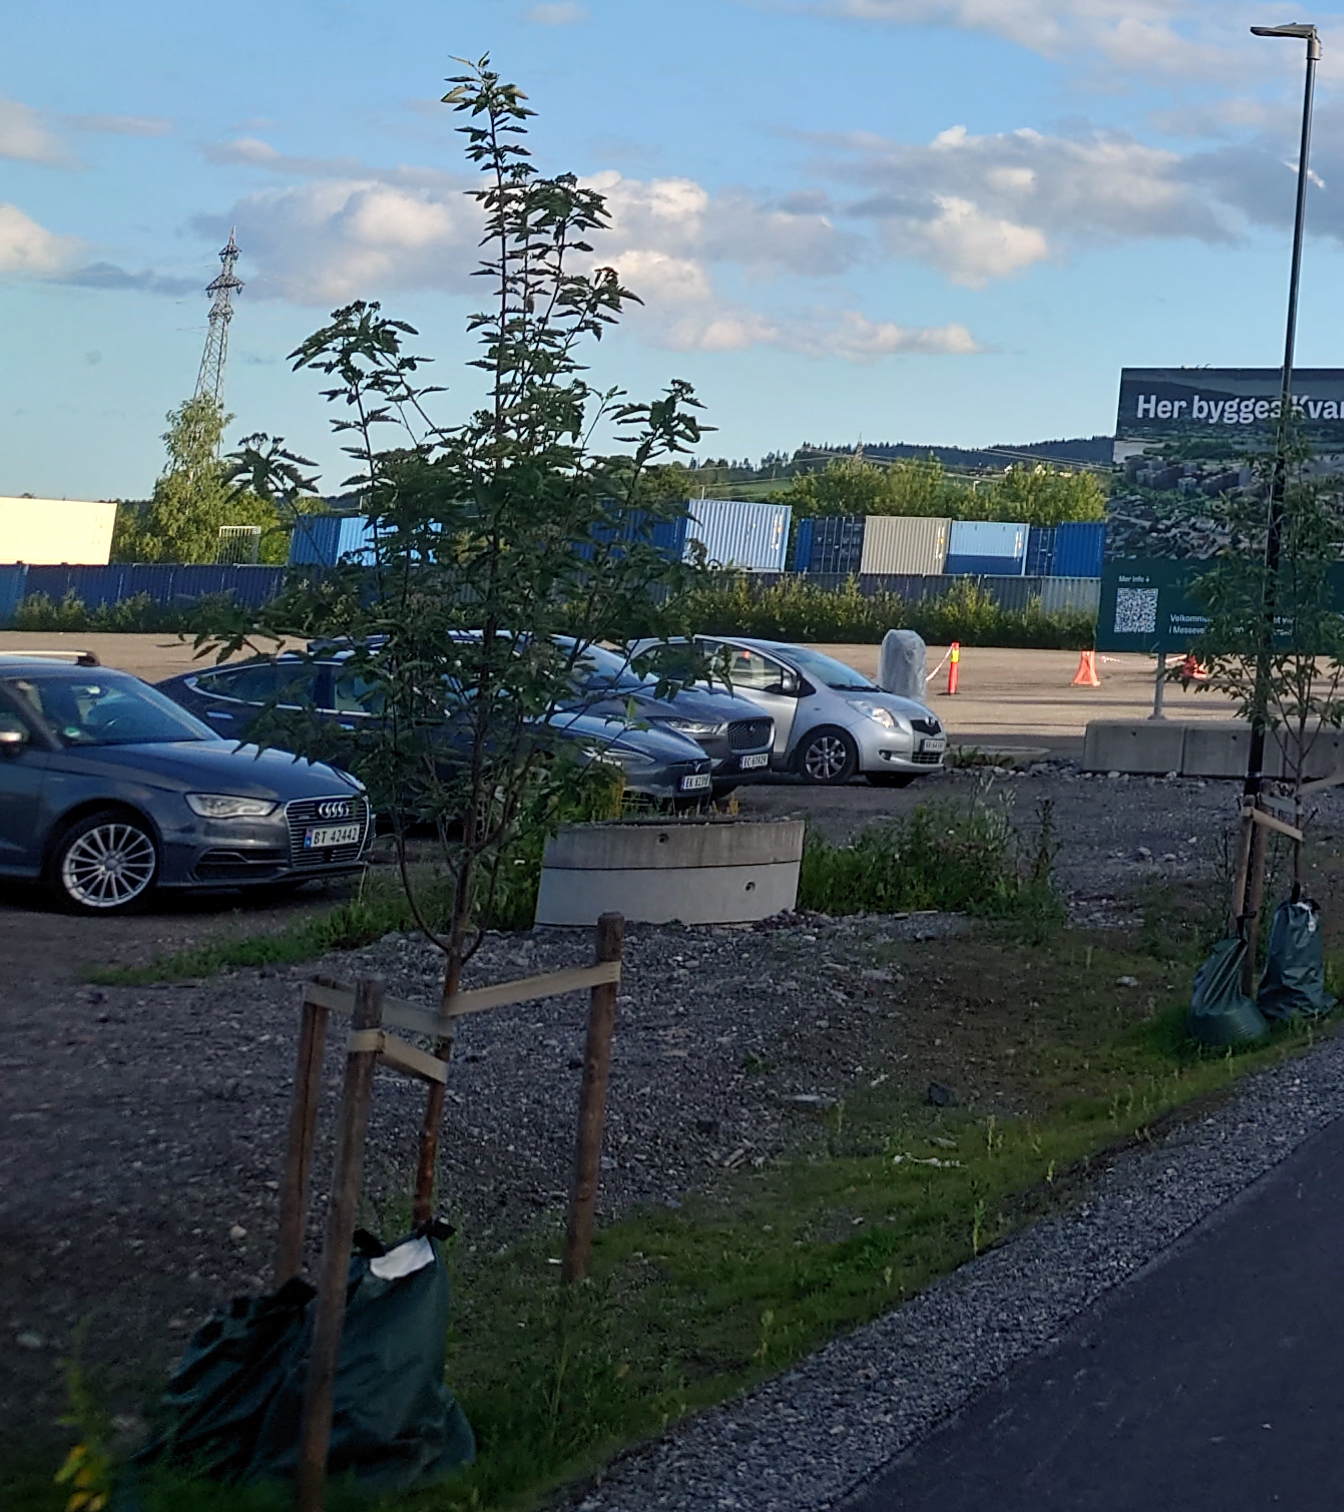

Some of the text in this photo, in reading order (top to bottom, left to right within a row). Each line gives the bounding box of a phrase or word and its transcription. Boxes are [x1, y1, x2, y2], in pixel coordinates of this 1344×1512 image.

[1136, 395, 1187, 419] Her
[1192, 395, 1282, 424] bygges
[313, 827, 358, 845] BT 42442
